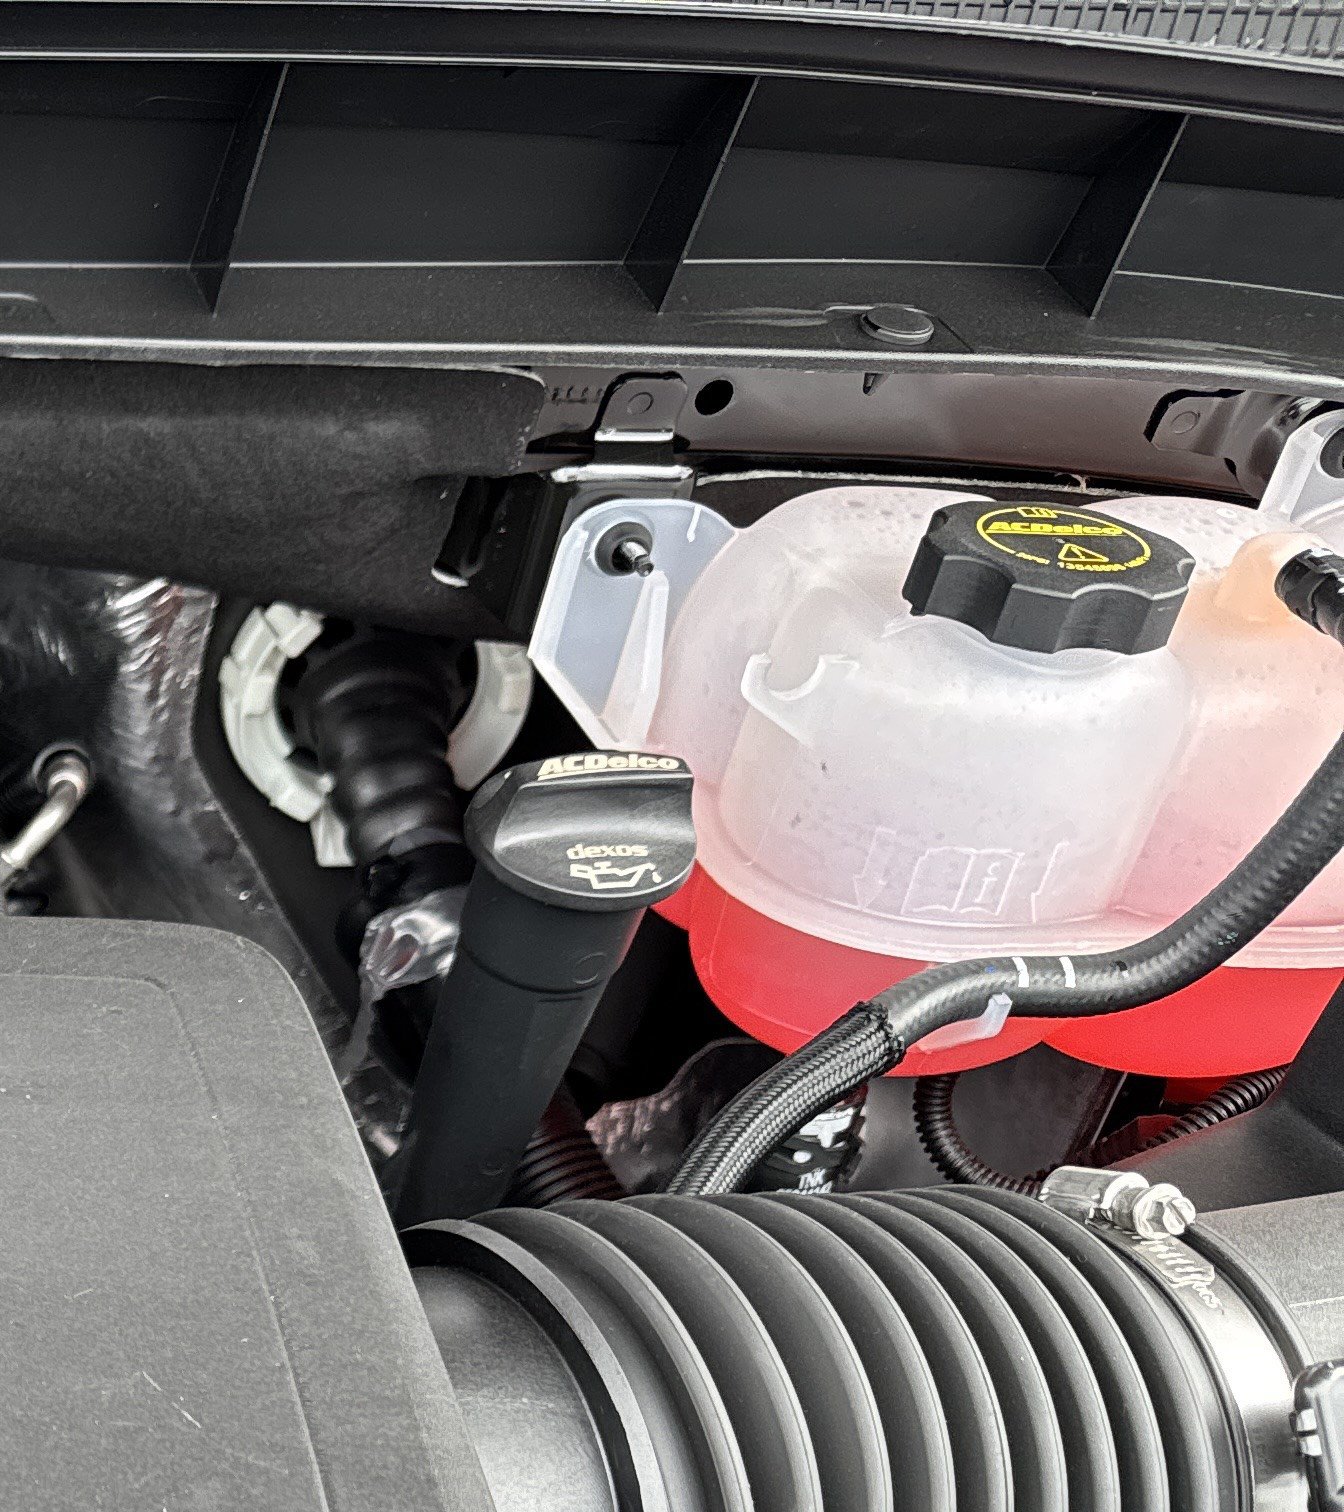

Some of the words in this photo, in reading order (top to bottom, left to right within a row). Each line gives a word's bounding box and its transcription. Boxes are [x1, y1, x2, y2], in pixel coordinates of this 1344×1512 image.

[986, 521, 1125, 536] ACDelco
[538, 754, 680, 778] ACDelco
[567, 844, 649, 859] dexos
